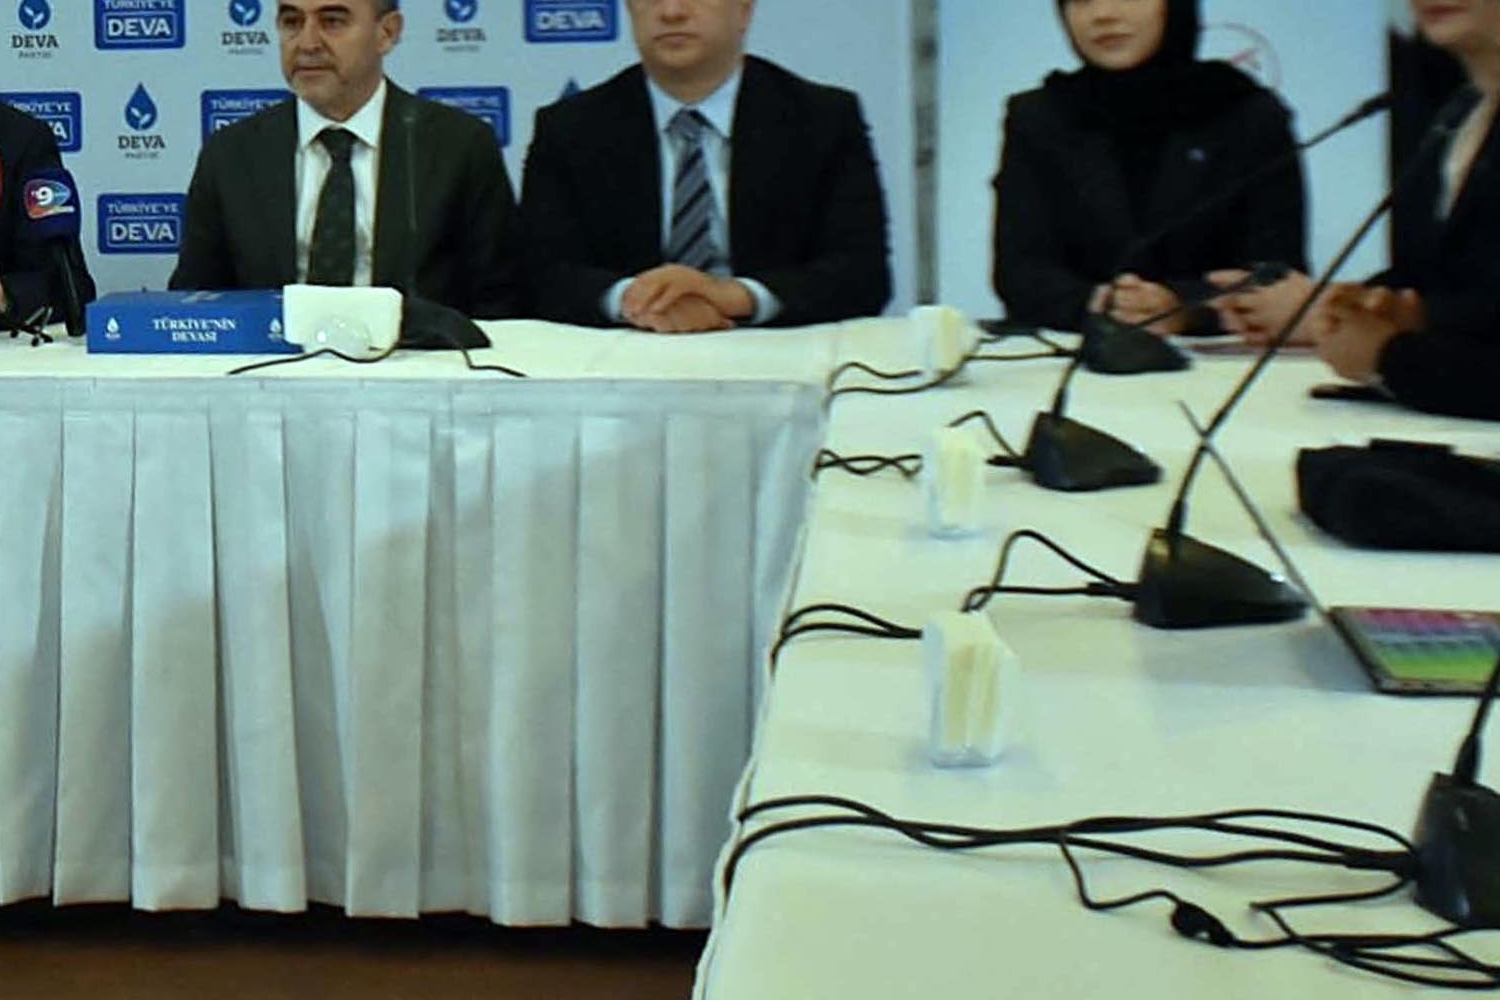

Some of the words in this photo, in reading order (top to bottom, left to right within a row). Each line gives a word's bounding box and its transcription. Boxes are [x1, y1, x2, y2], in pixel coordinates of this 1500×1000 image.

[108, 18, 171, 36] DEVA
[535, 10, 606, 30] DEVA
[11, 35, 60, 49] DEVA
[222, 31, 270, 46] DEVA
[117, 135, 166, 149] DEVA
[111, 222, 175, 241] DEVA
